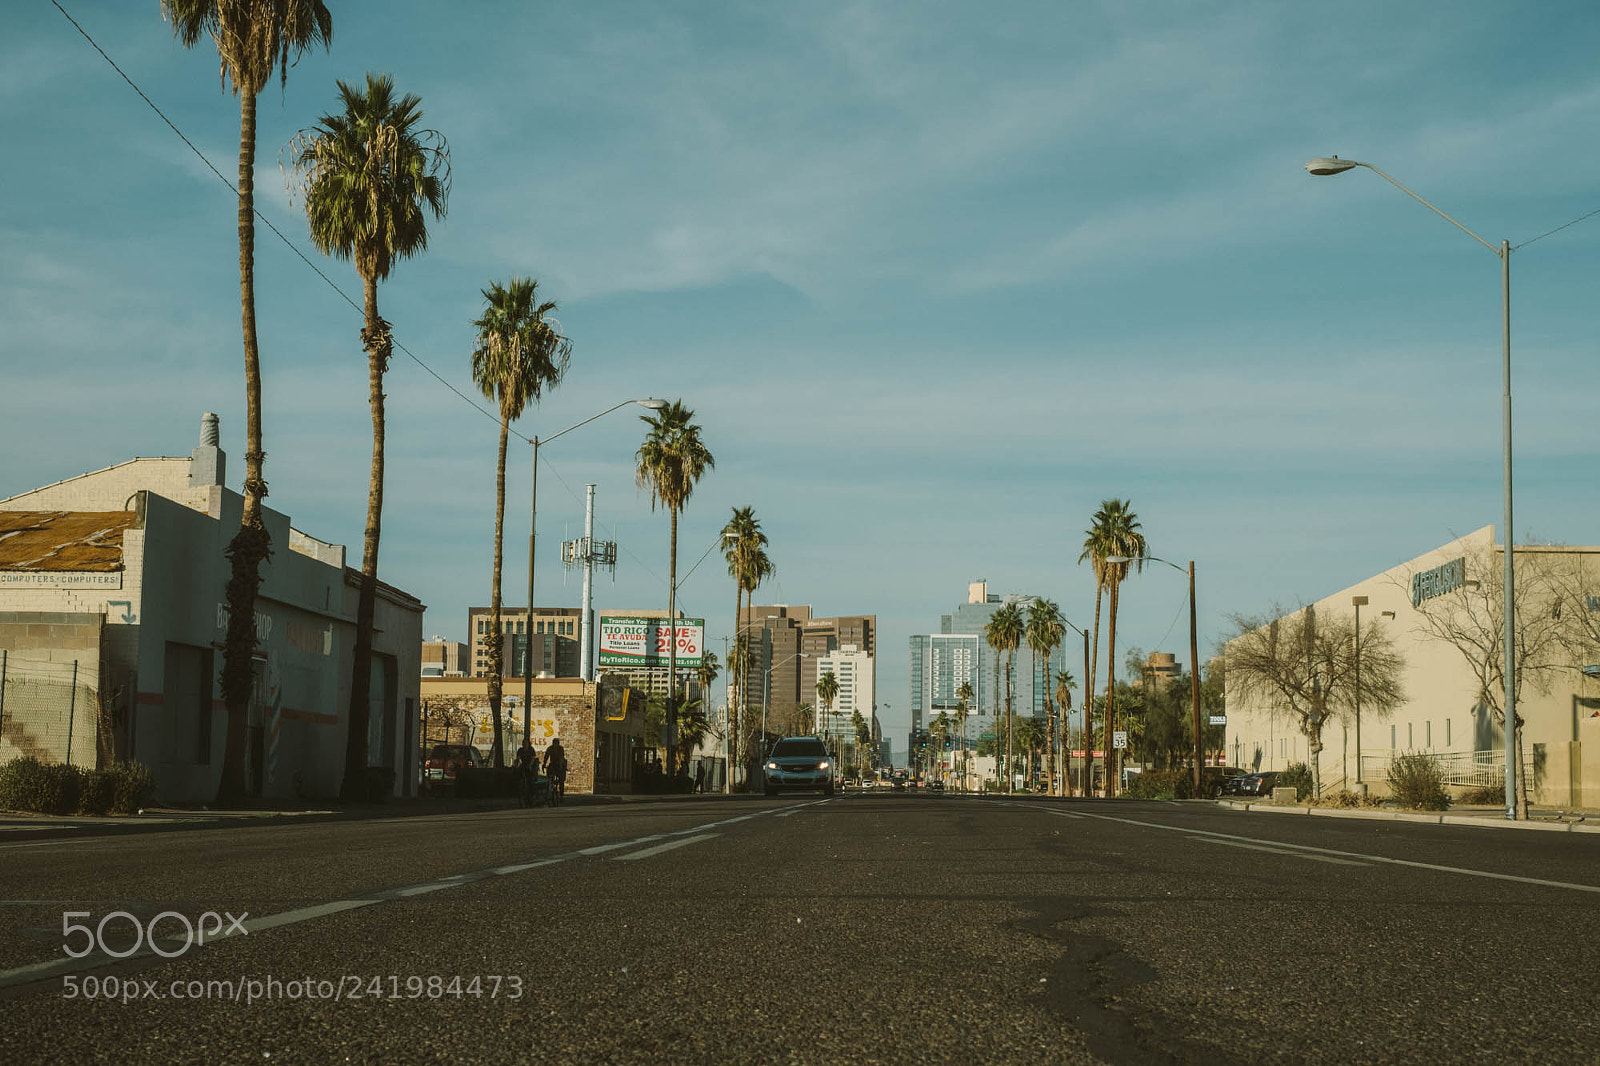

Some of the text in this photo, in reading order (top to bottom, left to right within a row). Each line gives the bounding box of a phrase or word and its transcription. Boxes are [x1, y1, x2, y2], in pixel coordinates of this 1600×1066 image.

[603, 626, 650, 635] TIO RICO
[655, 627, 690, 638] SAVE
[654, 638, 697, 654] 25%
[1115, 739, 1126, 747] 35
